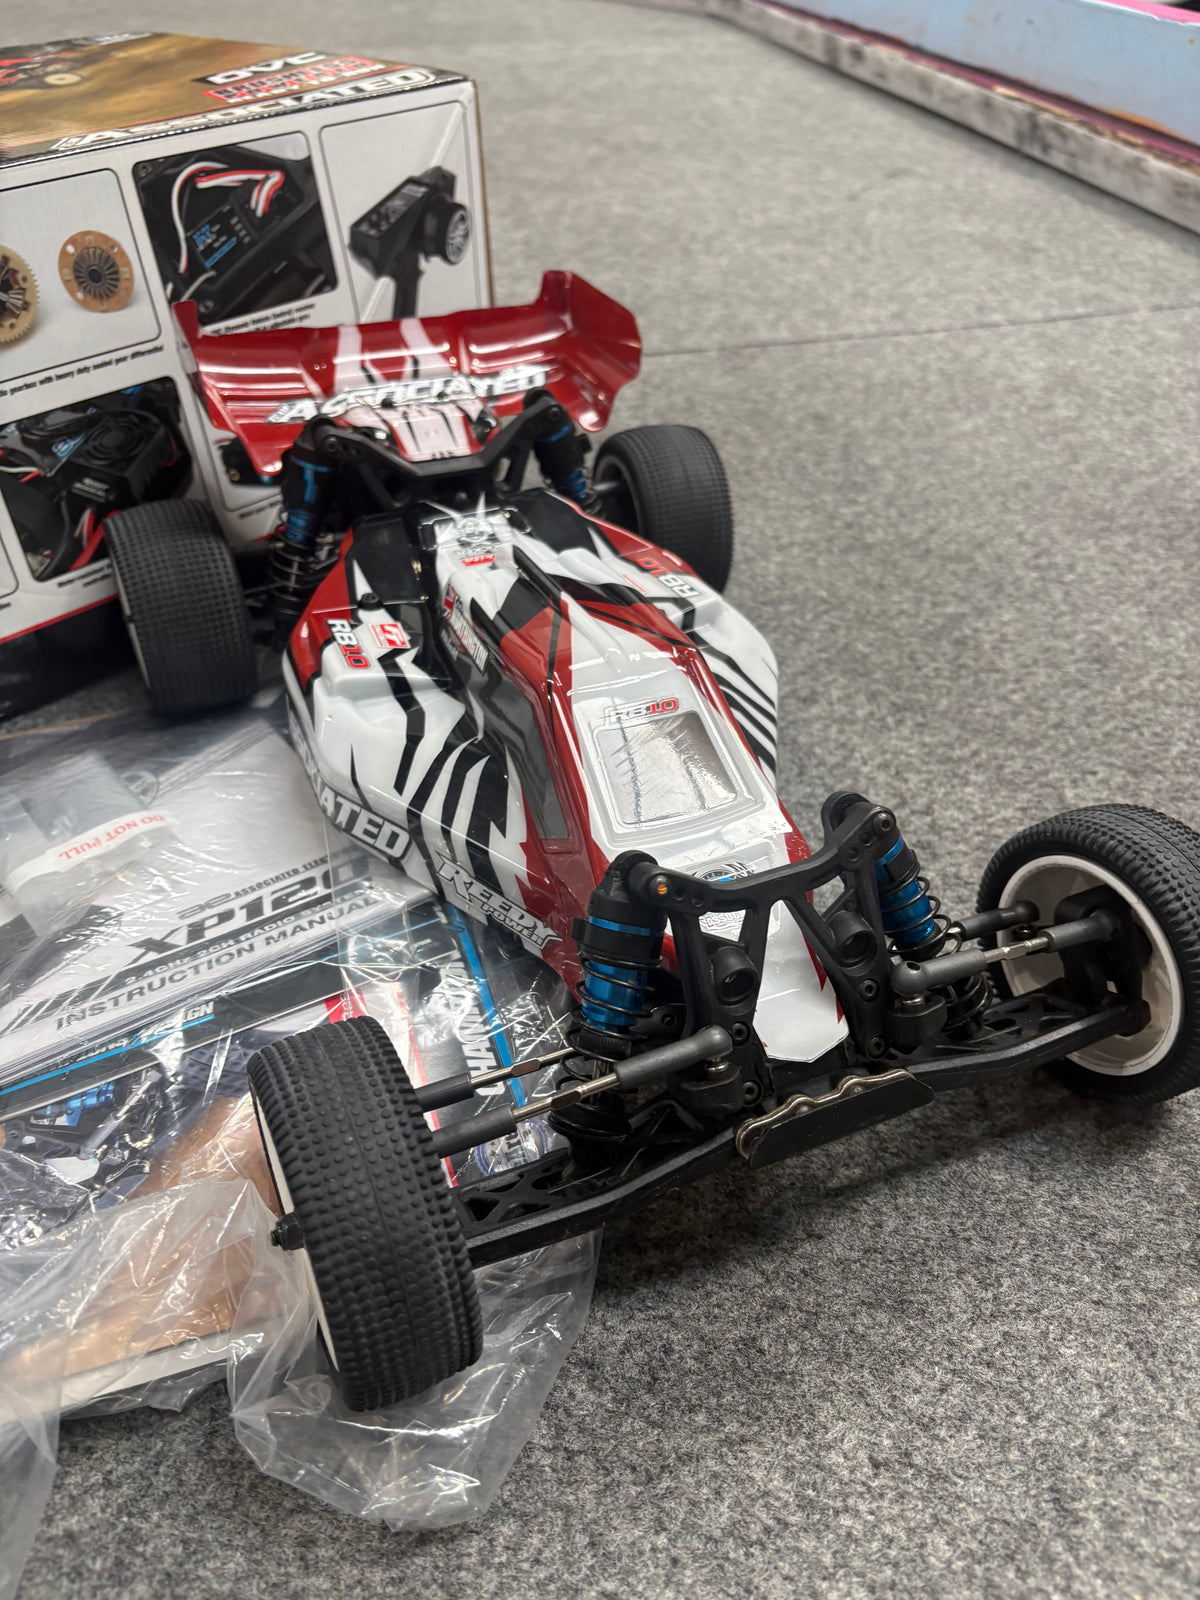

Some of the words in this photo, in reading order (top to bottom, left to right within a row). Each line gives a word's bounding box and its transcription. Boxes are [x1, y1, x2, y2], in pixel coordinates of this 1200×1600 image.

[77, 66, 428, 146] ASSOCIATED
[637, 558, 700, 598] RB10
[326, 618, 370, 669] RB10
[609, 699, 680, 724] RB10
[105, 820, 139, 843] NOT
[141, 814, 165, 825] DO
[58, 837, 102, 860] PULL
[233, 867, 301, 898] ASSOCIATED
[436, 851, 562, 943] REEDY
[125, 854, 370, 968] XP120
[240, 915, 296, 941] RADIO
[481, 903, 545, 948] POWER
[57, 943, 255, 1031] INSTRUCTION
[265, 895, 380, 947] MANUAL
